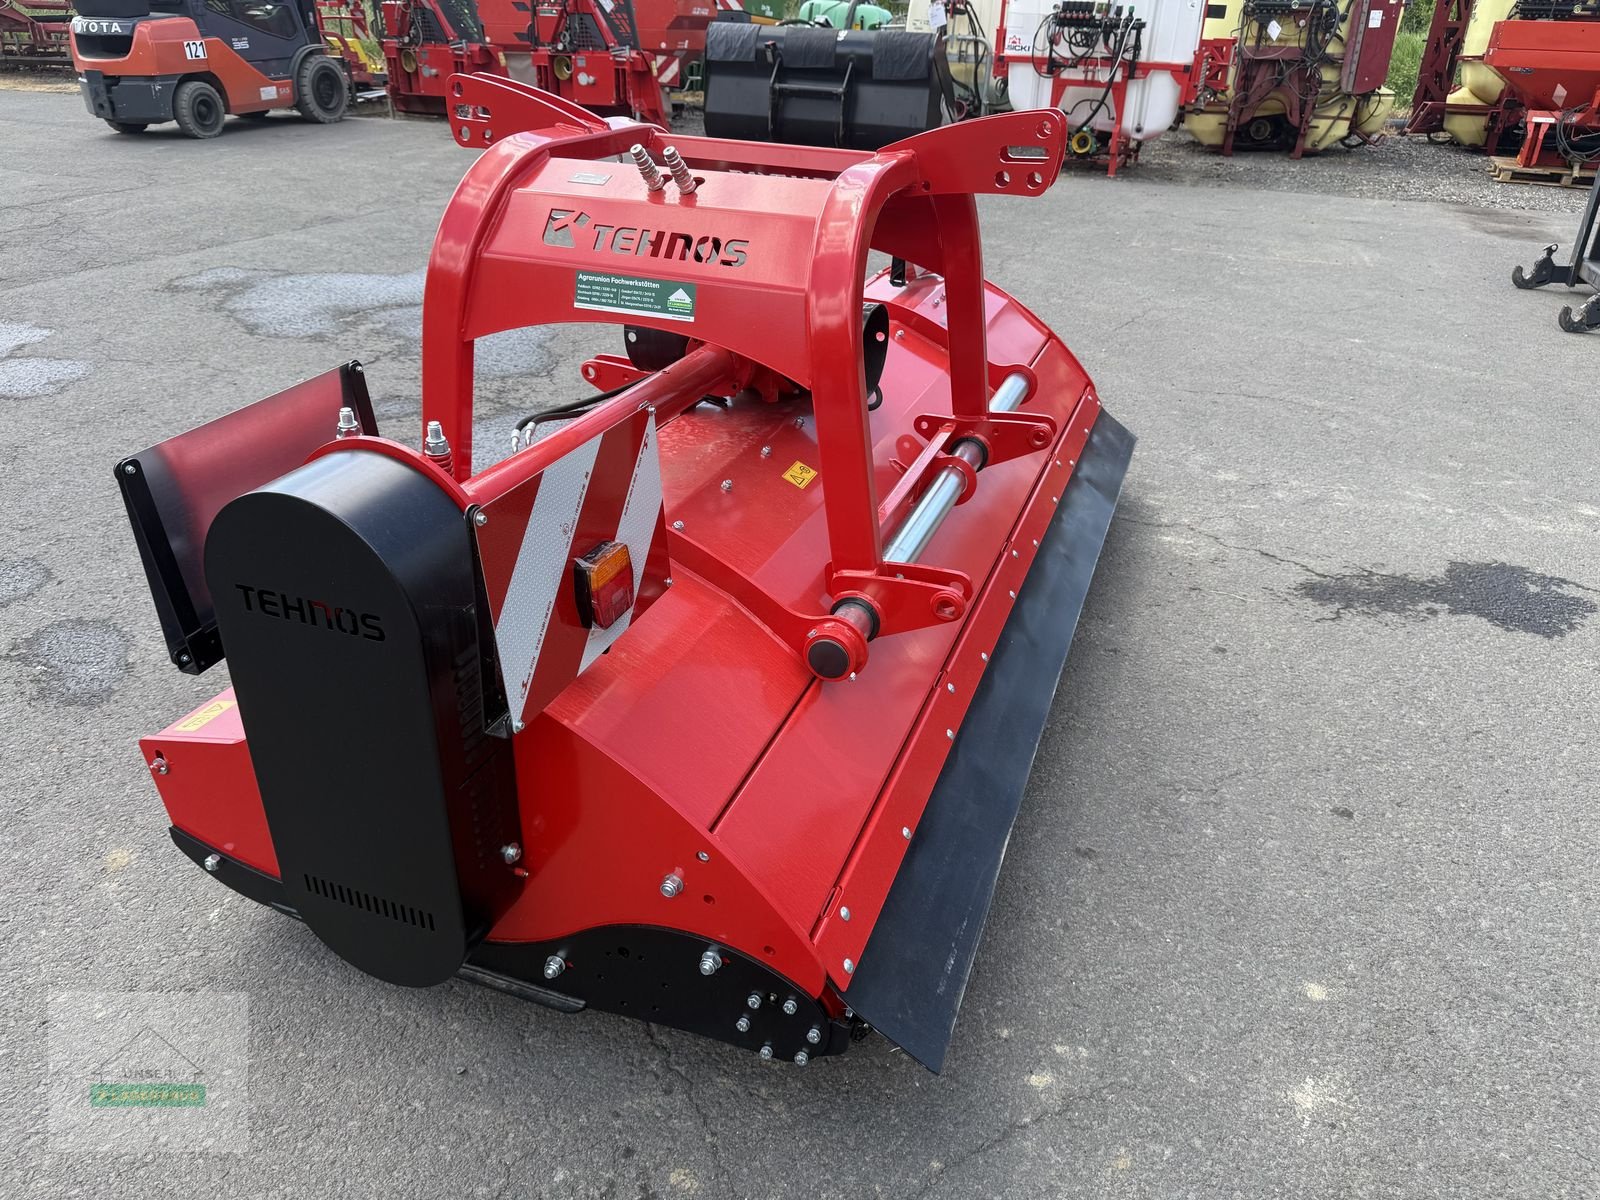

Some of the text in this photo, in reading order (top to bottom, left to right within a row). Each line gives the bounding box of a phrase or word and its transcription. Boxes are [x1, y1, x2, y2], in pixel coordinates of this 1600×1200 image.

[185, 42, 206, 59] 121
[232, 41, 249, 50] 35
[593, 224, 750, 267] TEHNOS
[235, 583, 386, 642] TEHNOS
